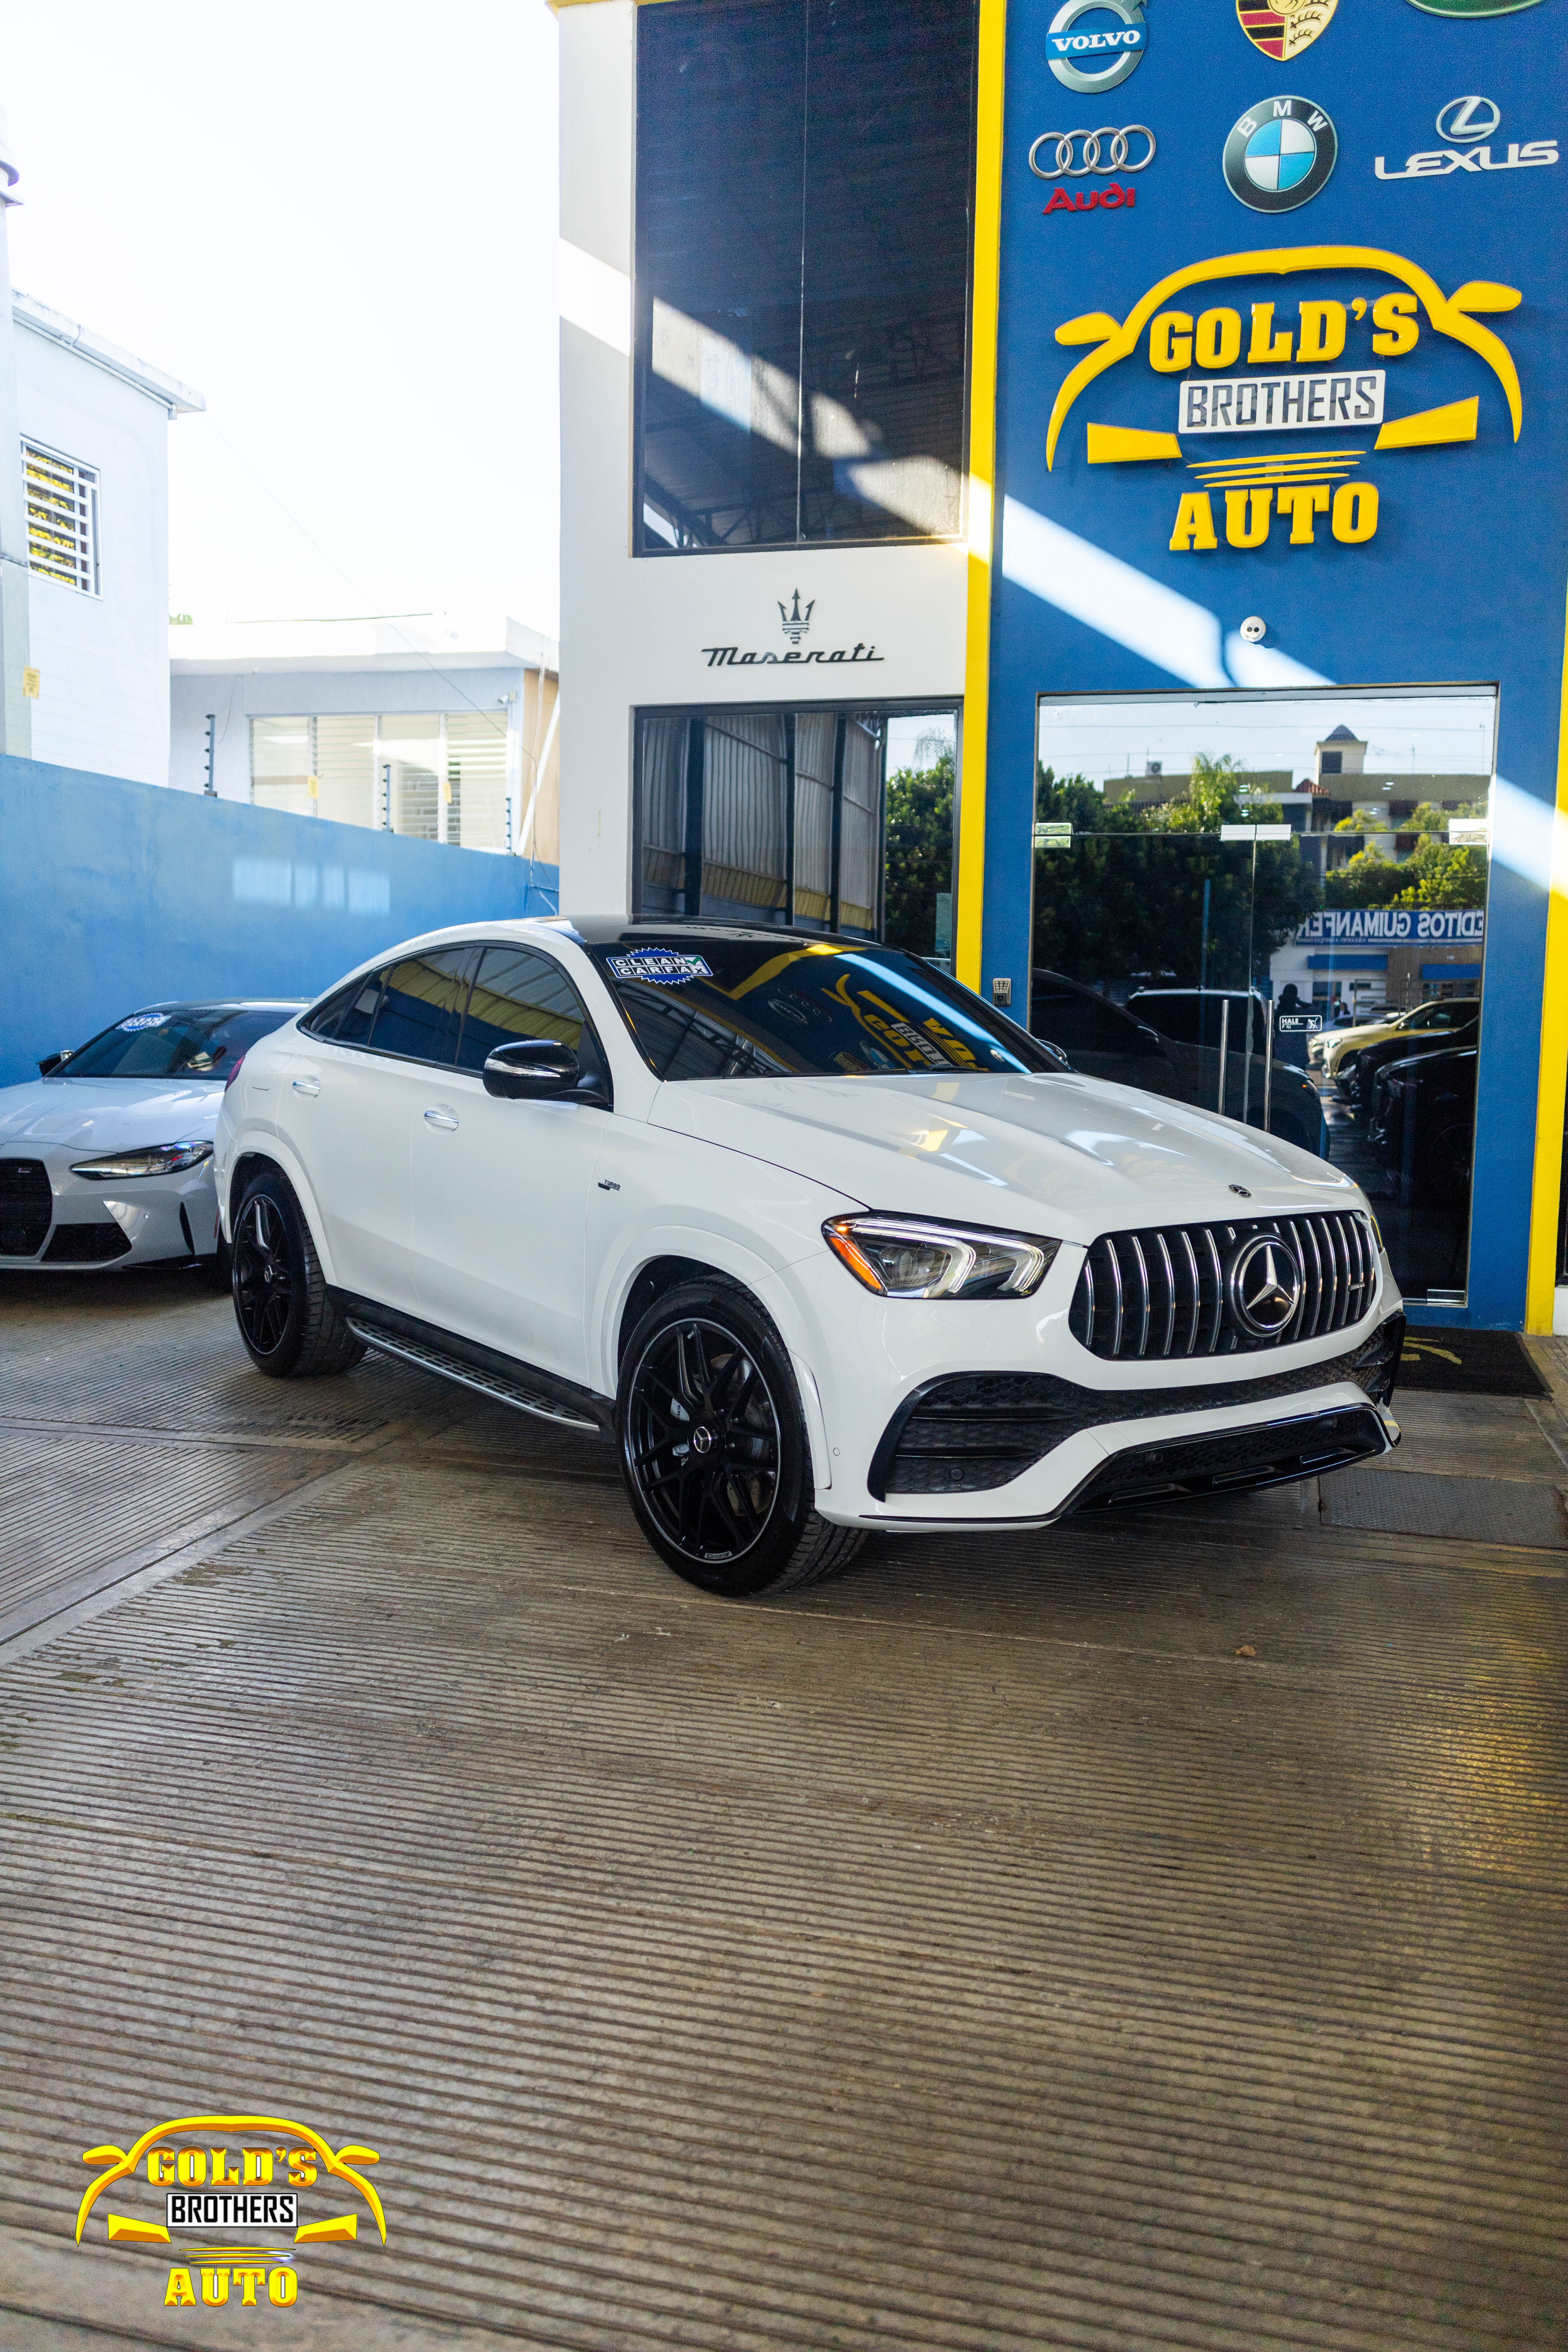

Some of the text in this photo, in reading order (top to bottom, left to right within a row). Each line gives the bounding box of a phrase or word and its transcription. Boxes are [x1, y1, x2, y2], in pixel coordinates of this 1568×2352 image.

[1052, 30, 1140, 52] VOLVO
[1237, 100, 1328, 138] BMW
[1375, 140, 1559, 180] LEXUS
[1043, 182, 1135, 215] Audi
[1148, 292, 1419, 373] GOLD'S
[1186, 375, 1377, 429] BROTHERS
[1169, 482, 1379, 551] AUTO
[701, 642, 885, 667] Maserati
[615, 957, 686, 966] CLEAN
[620, 966, 706, 975] CARFAX
[604, 1179, 620, 1189] TURBO
